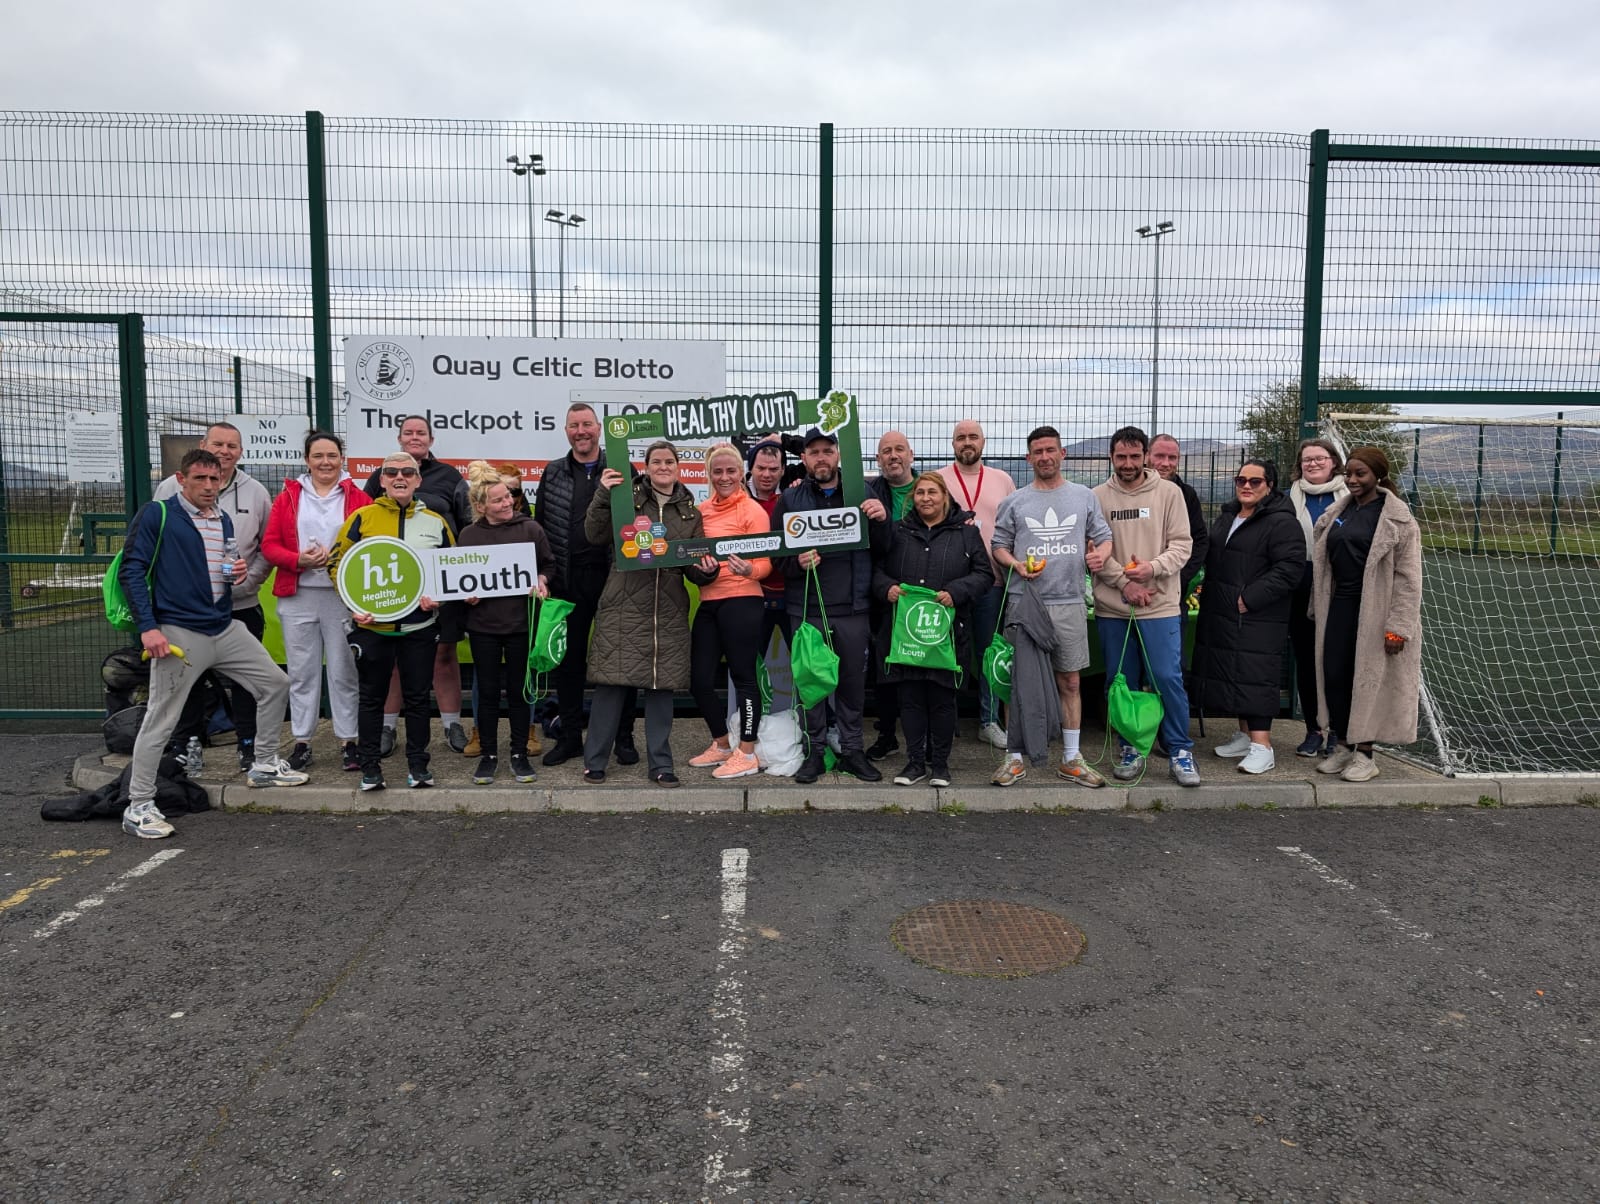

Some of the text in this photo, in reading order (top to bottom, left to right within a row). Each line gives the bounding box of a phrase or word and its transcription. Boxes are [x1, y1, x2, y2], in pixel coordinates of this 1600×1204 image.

[359, 349, 375, 368] QUAY
[375, 344, 405, 360] CELTIC
[432, 354, 674, 380] Quay Celtic Blotto
[369, 388, 384, 398] EST
[361, 408, 407, 429] The
[534, 411, 555, 431] is
[666, 396, 795, 437] HEALTHY LOUTH
[259, 420, 277, 430] NO
[613, 421, 625, 432] hi
[250, 434, 287, 445] DOGS
[242, 449, 302, 460] LLOWED
[807, 512, 858, 531] LLSP
[1110, 509, 1140, 521] PUMA
[718, 540, 767, 552] SUPPORTED
[768, 539, 778, 548] BY
[1026, 542, 1078, 556] adidas
[439, 552, 489, 565] Healthy
[360, 552, 403, 590] hi
[441, 563, 532, 594] Louth
[362, 588, 397, 602] Healthy
[375, 594, 407, 608] Ireland
[917, 605, 941, 627] hi
[902, 648, 926, 658] Louth
[744, 698, 752, 735] MOTIVATE
